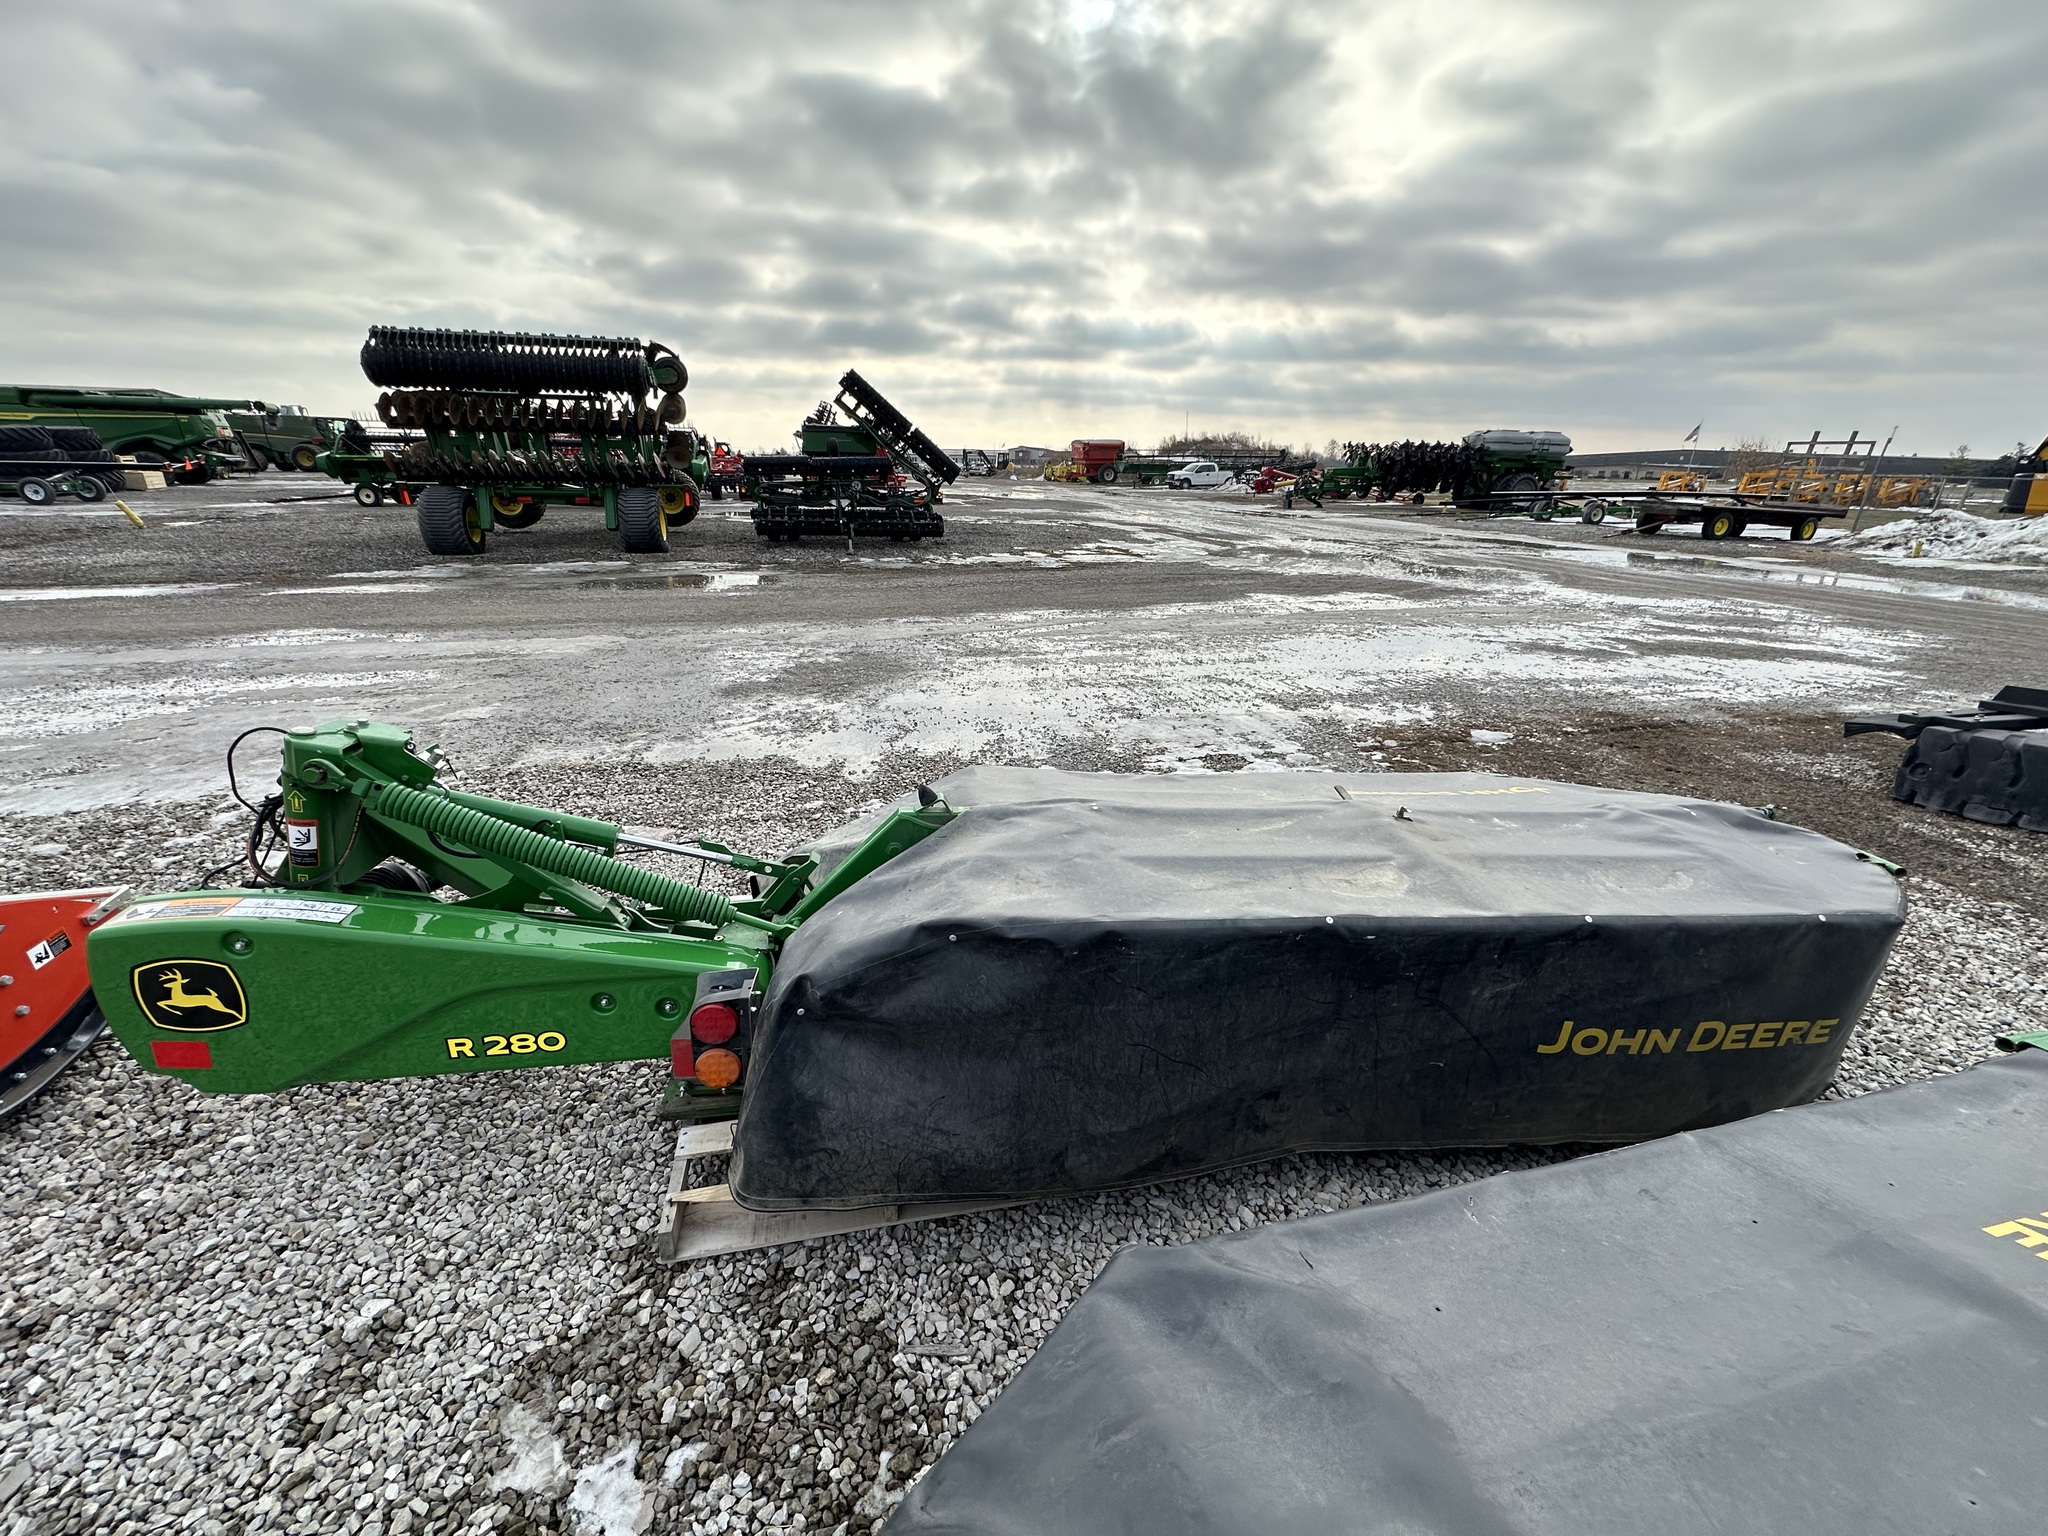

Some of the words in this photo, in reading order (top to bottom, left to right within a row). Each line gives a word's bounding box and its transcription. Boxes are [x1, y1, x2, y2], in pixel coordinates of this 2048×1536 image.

[447, 1037, 476, 1059] R
[484, 1031, 567, 1056] 280
[1537, 1021, 1681, 1055] JOHN
[1687, 1019, 1840, 1052] DEERE
